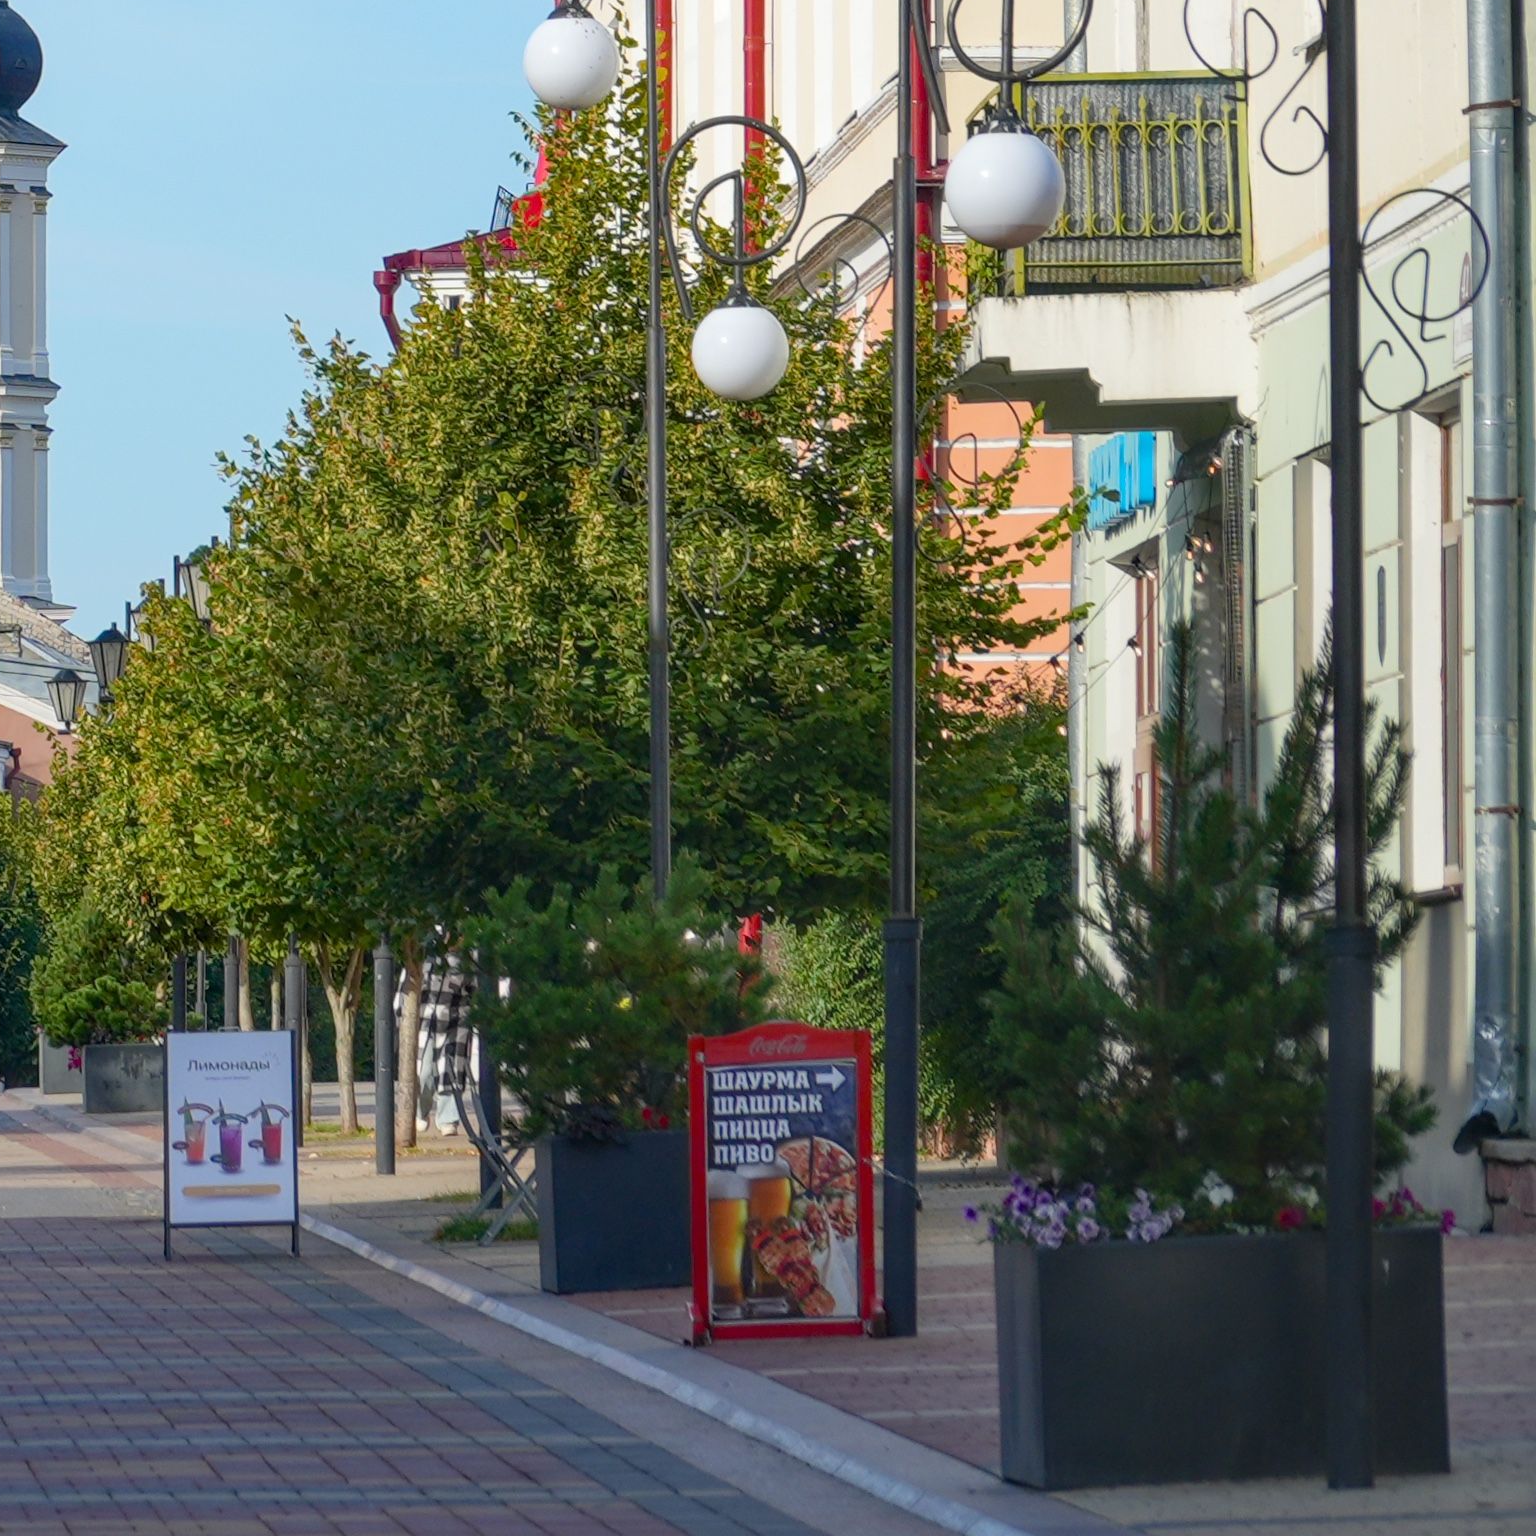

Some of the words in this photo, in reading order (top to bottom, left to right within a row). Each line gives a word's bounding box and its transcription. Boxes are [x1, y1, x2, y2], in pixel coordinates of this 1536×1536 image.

[188, 1060, 270, 1072] Лимонады
[713, 1071, 810, 1091] ШАУРМА
[713, 1094, 823, 1115] ШАШЛЫК
[713, 1119, 791, 1141] ПИЦЦА
[714, 1144, 774, 1164] ПИВО
